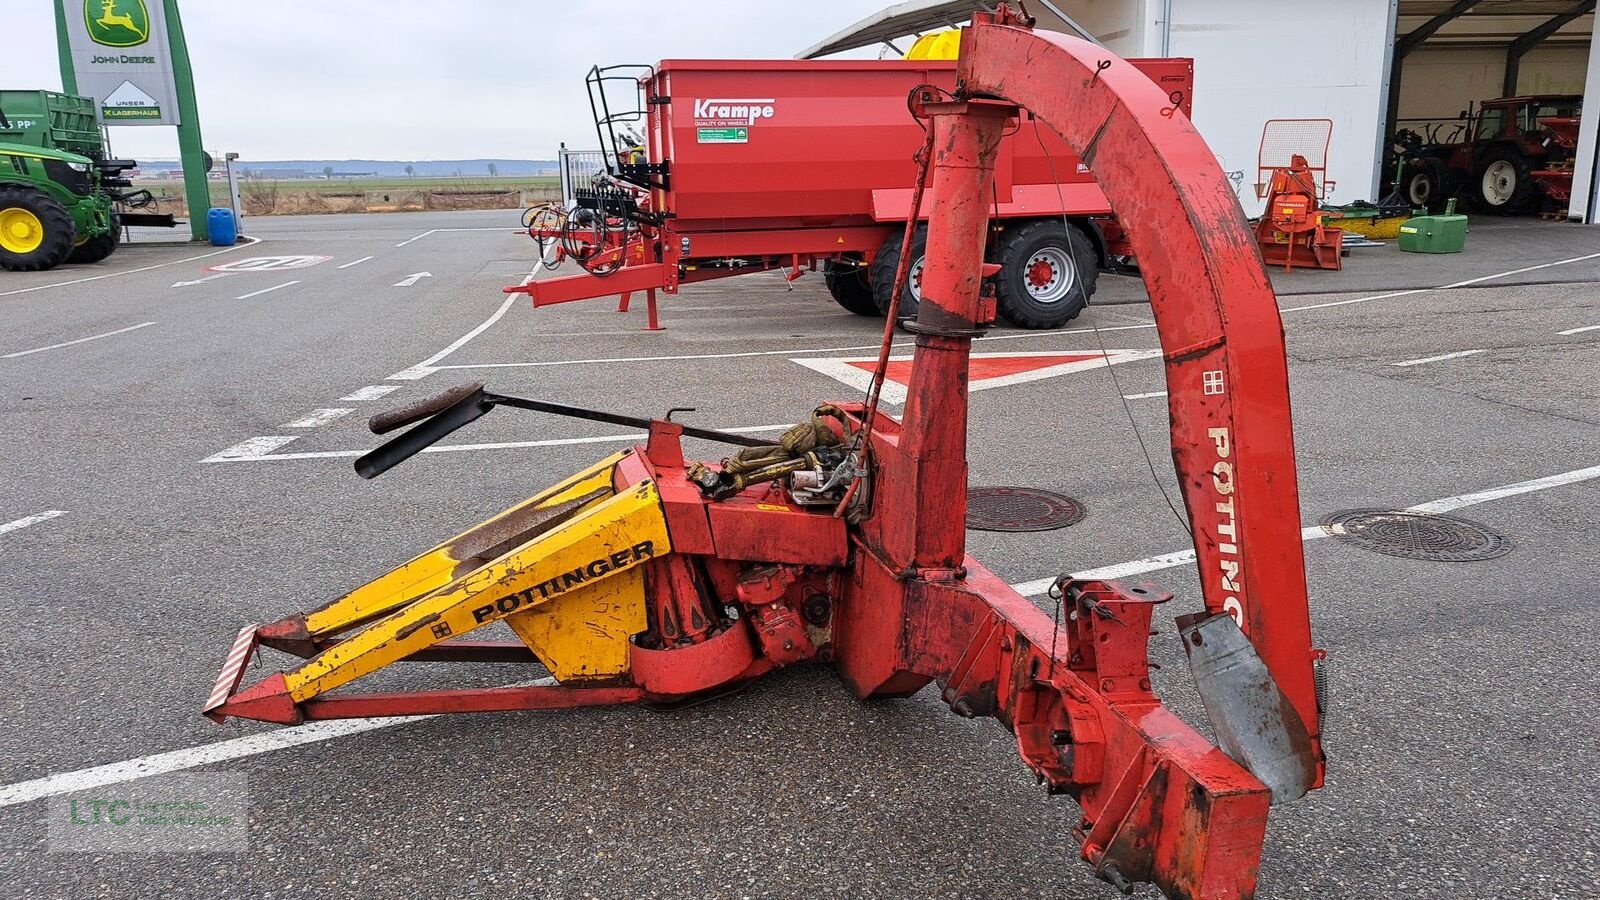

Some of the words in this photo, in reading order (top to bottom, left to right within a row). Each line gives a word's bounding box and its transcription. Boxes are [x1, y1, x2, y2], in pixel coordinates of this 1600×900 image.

[91, 55, 119, 64] JOHN
[120, 55, 155, 64] DEERE
[694, 98, 775, 126] Krampe
